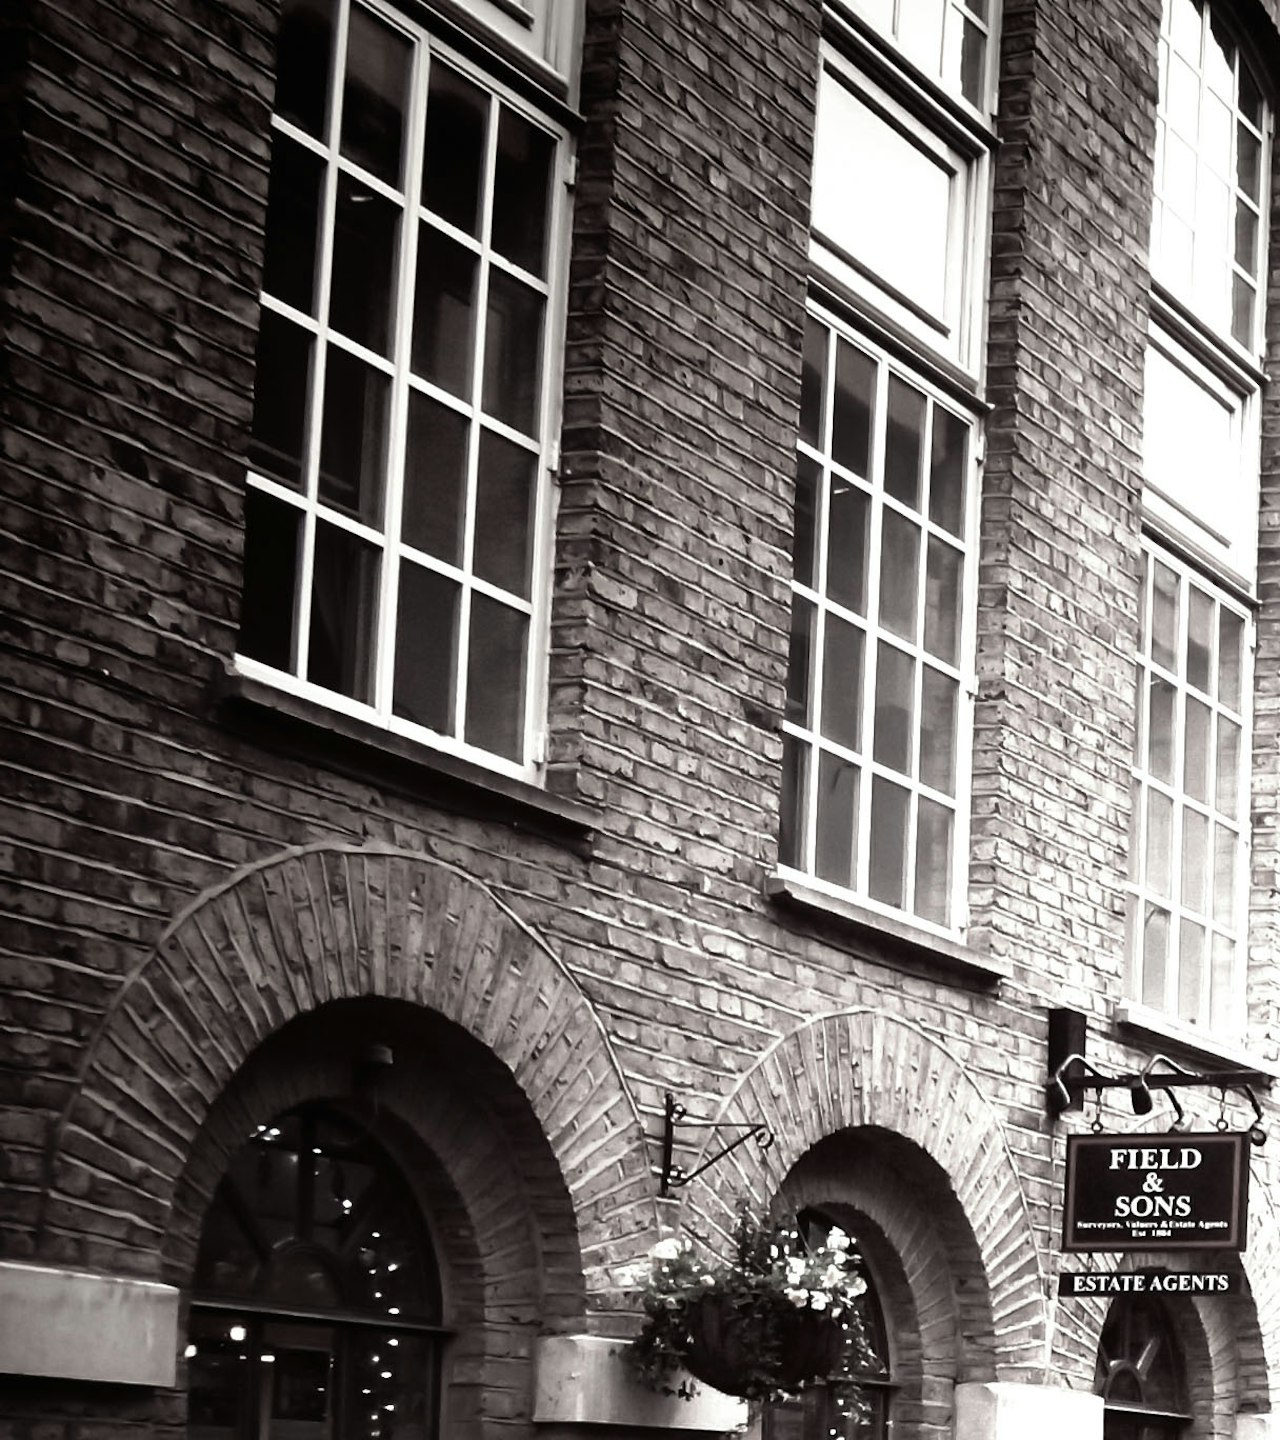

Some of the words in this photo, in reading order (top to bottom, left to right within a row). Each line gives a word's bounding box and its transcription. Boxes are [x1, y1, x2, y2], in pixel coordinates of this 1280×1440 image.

[1108, 1148, 1202, 1171] FIELD
[1142, 1172, 1164, 1193] &
[1114, 1195, 1191, 1218] SONS
[1073, 1275, 1145, 1292] ESTATE
[1150, 1275, 1229, 1291] AGENTS
